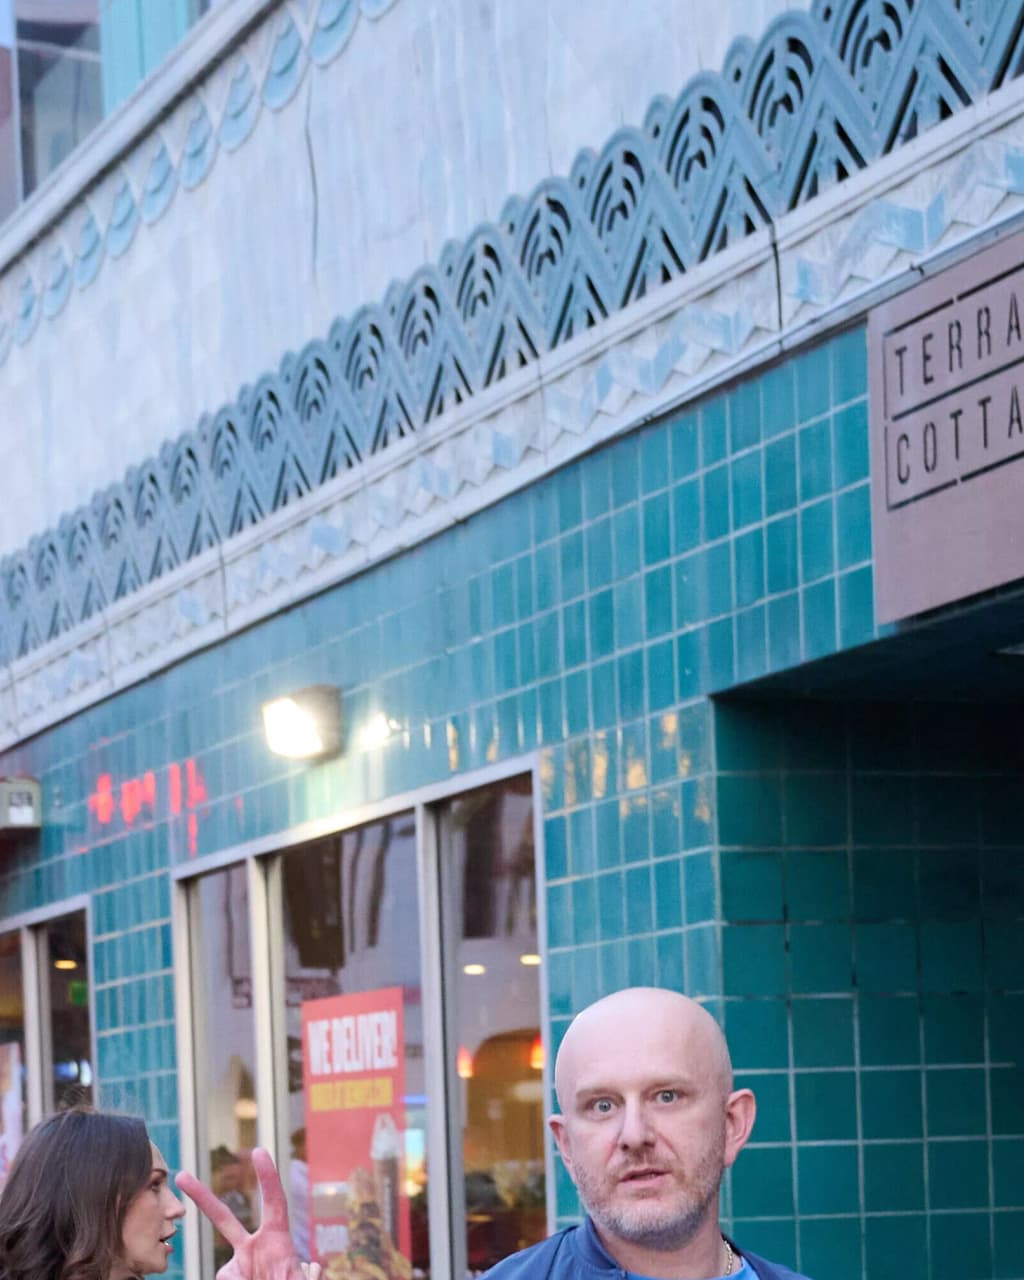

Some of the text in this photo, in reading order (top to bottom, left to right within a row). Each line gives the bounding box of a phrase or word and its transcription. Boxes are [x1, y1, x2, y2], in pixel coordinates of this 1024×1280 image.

[894, 293, 1023, 397] TERRA
[896, 385, 1024, 485] COTTA
[307, 1019, 332, 1076] WE
